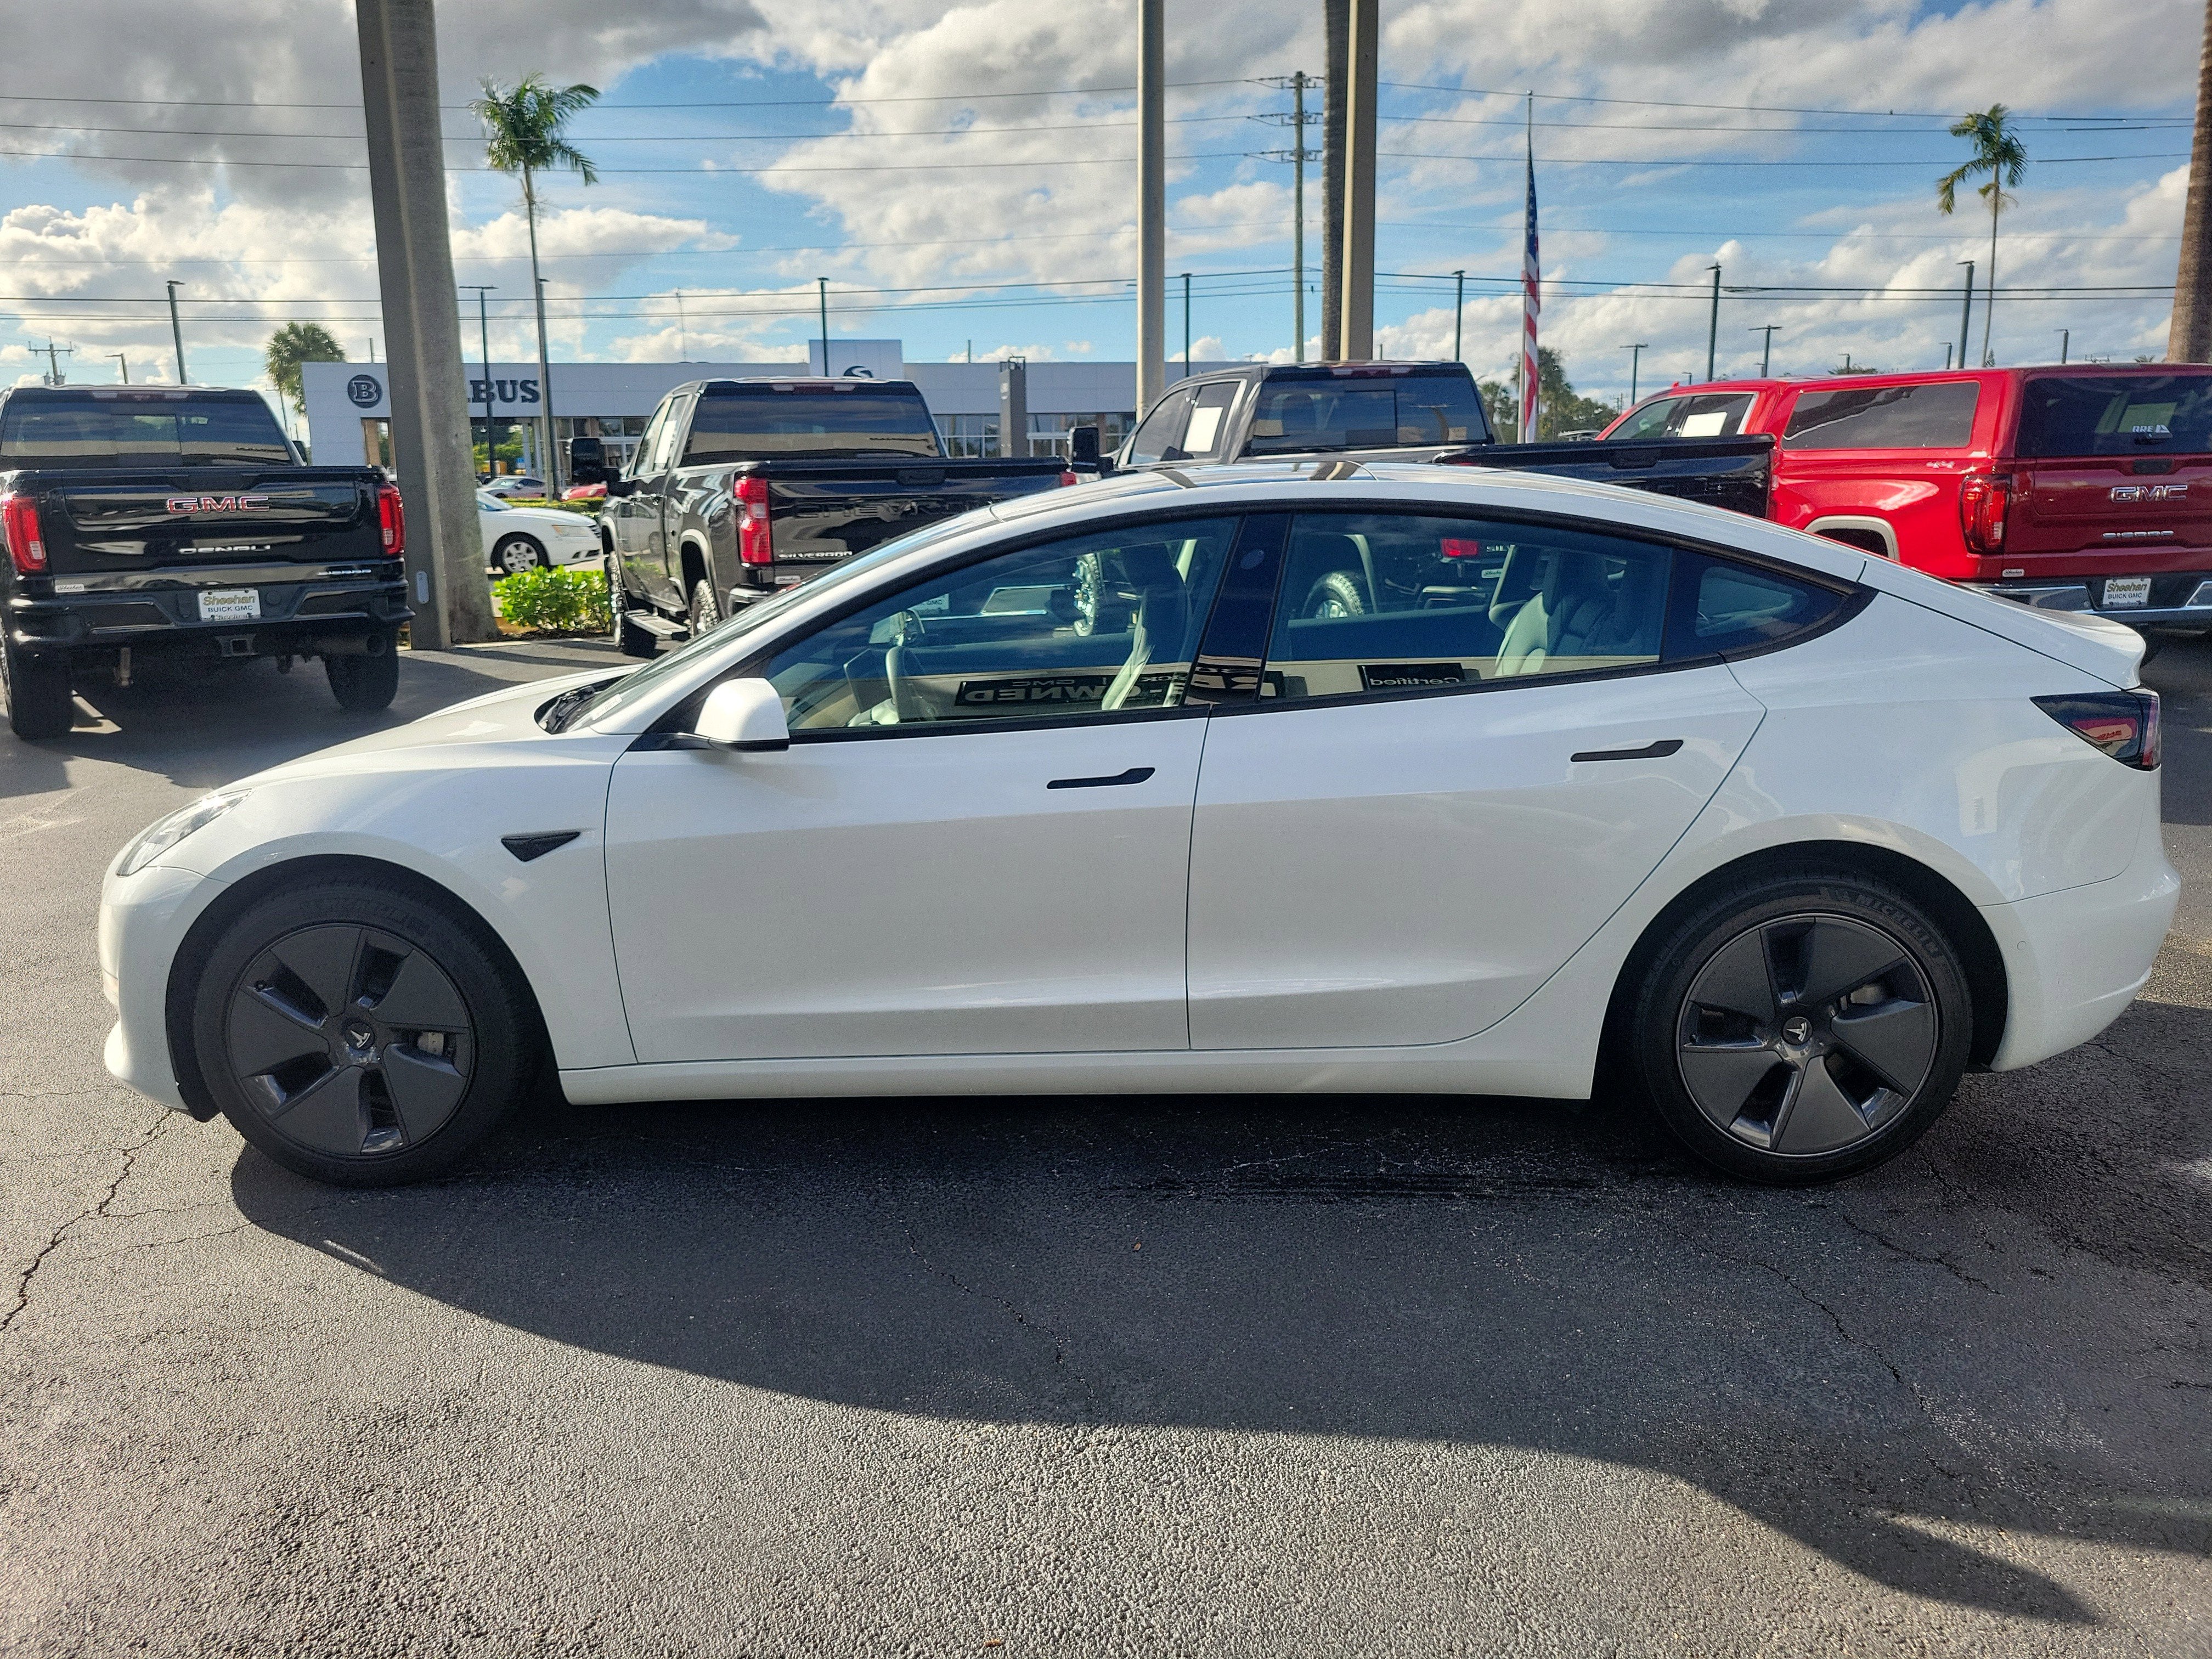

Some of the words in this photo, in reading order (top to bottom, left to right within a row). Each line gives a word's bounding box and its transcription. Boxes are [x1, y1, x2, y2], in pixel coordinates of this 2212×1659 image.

[467, 379, 541, 403] BUS
[2110, 485, 2188, 503] GMC
[166, 496, 270, 514] GMC
[178, 545, 271, 554] DENALI
[2107, 582, 2147, 592] Sheehan
[204, 595, 256, 606] Sheehan
[1856, 894, 1939, 956] MICHELIN
